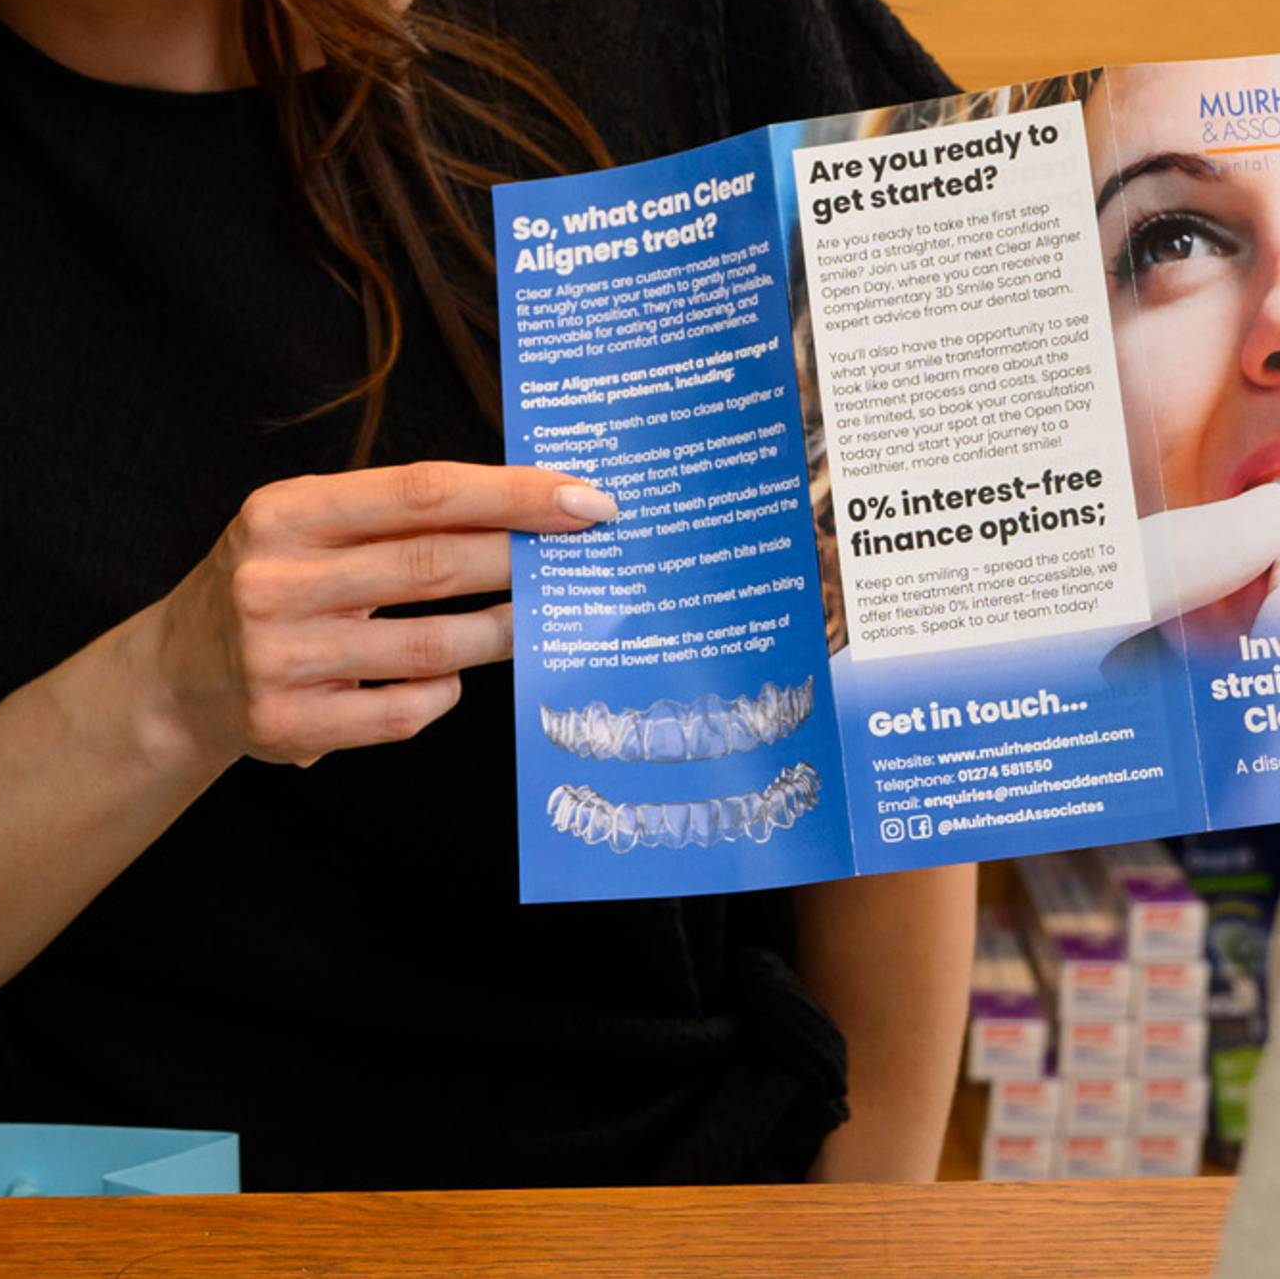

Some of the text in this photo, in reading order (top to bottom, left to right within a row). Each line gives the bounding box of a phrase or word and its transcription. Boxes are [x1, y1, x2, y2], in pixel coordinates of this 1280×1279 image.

[809, 124, 1058, 184] Are you ready to
[1202, 120, 1217, 144] &
[513, 172, 754, 242] So, what can Clear
[812, 165, 997, 223] get started?
[514, 213, 717, 274] Aligners treat?
[816, 203, 1049, 250] Are you ready to take the first step
[817, 217, 1060, 266] toward a straighter, more confident
[515, 240, 769, 301] Clear Aligners are custom-made trays that
[516, 262, 756, 316] fit snugly over your teeth to gently move
[820, 251, 1063, 300] Open Day, where you can receive a
[822, 266, 1061, 315] complimentary 3D Smile Scan and
[519, 336, 778, 393] Clear Aligners can correct a wide range of
[520, 367, 734, 409] orthodontic problems, including:
[834, 364, 1091, 412] treatment process and costs. Spaces
[532, 385, 784, 438] Crowding: teeth are too close together or
[534, 434, 618, 453] overlapping
[847, 469, 1102, 522] 0% interest-free
[850, 502, 1104, 556] finance options;
[541, 575, 804, 619] Open bite: teeth do not meet when biting
[856, 561, 1117, 606] make treatment more accessible, we
[858, 579, 1113, 624] offer flexible 0% interest-free finance
[541, 621, 582, 632] down
[542, 613, 789, 654] Misplaced midline: the center lines of
[543, 636, 774, 671] upper and lower teeth do not align
[868, 690, 1087, 736] Get in touch...
[872, 728, 1134, 771] Website: www.muirheaddental.com
[1236, 759, 1248, 775] A
[875, 758, 1052, 792] Telephone: 01274 581550
[877, 766, 1163, 813] Email: enquiries@muirheaddental.com
[937, 801, 1104, 835] @MuirheadAssociates
